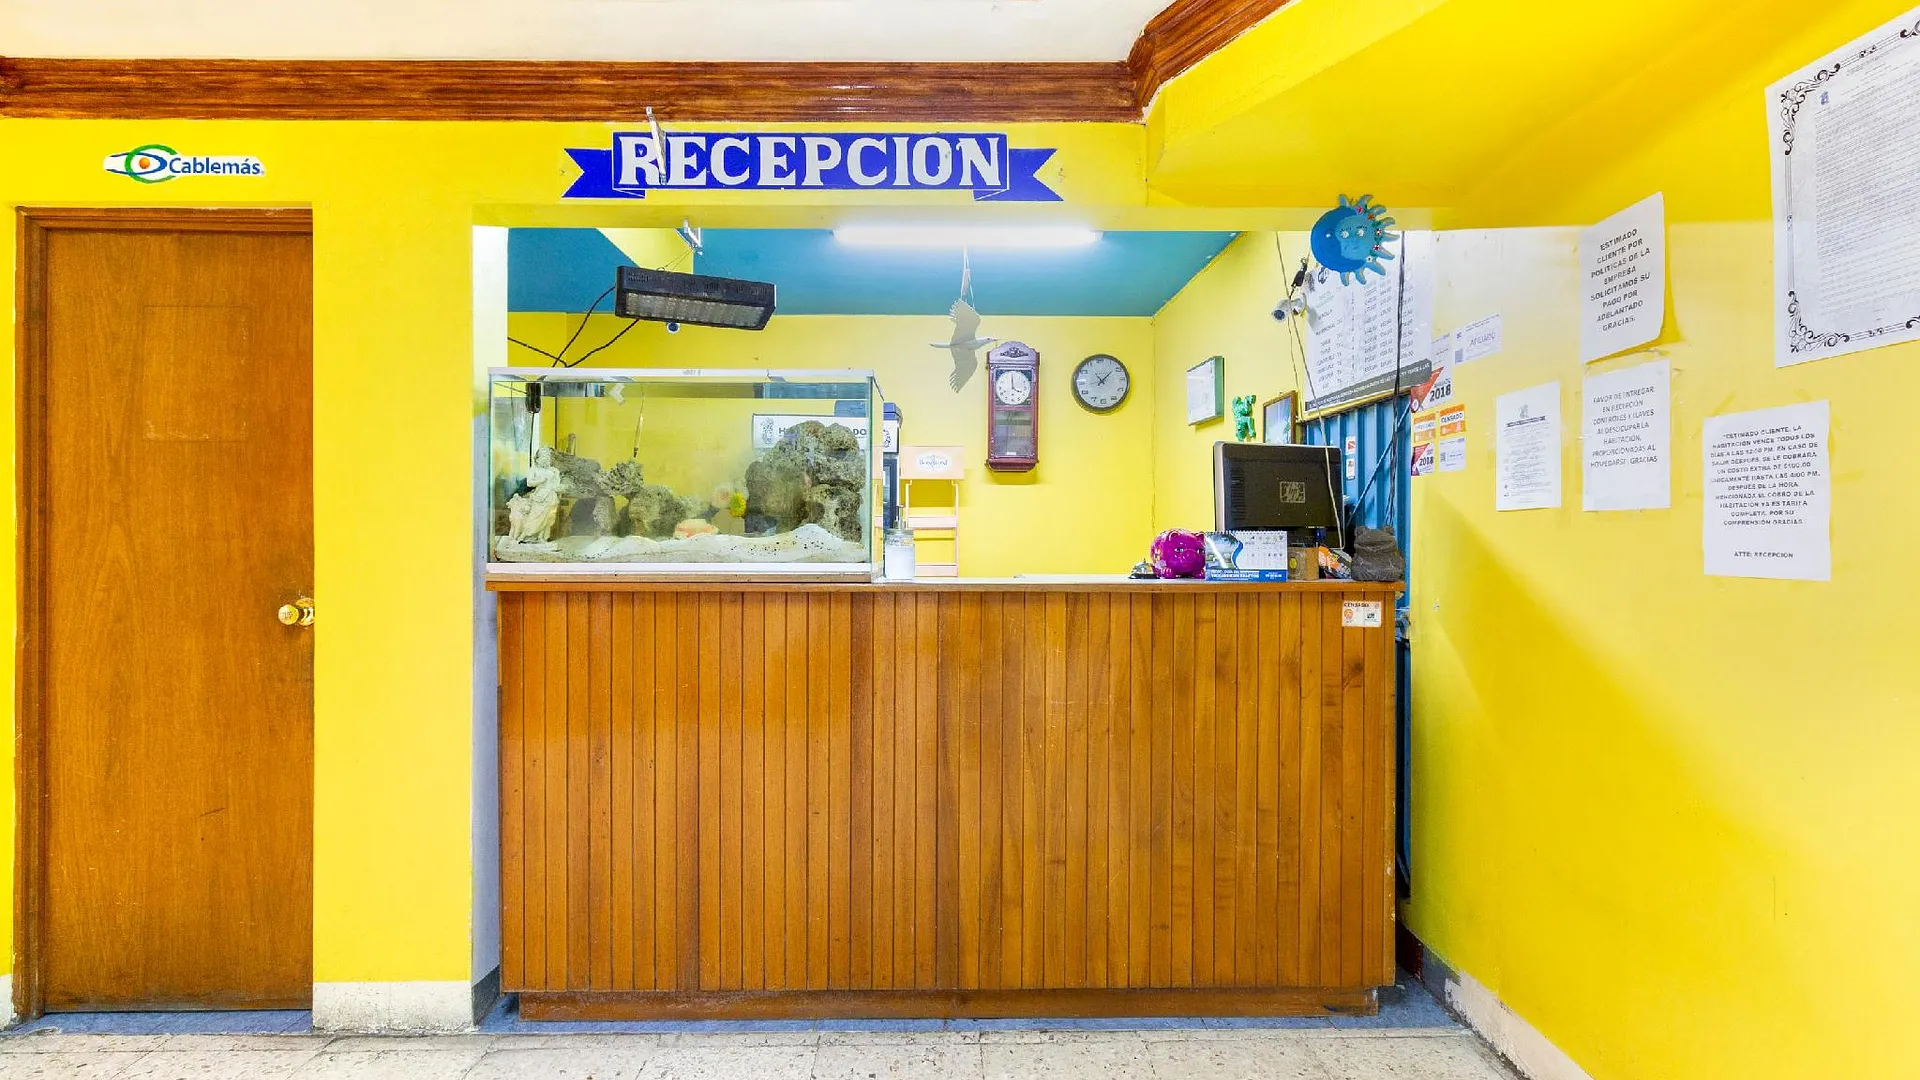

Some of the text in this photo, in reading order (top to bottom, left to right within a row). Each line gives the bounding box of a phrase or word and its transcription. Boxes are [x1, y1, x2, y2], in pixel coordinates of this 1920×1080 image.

[169, 157, 261, 175] Cablemás
[618, 135, 1002, 187] RECEPCION
[1600, 228, 1637, 250] ESTIMADO
[1597, 238, 1642, 263] CLIENTE POR
[1591, 248, 1650, 278] POLITICAS DE LA
[1604, 265, 1636, 285] EMPRESA
[1590, 272, 1650, 301] SOLICITAMOS SU
[1602, 289, 1638, 308] PAGO POR
[1597, 299, 1643, 322] ADELANTADO
[1429, 383, 1452, 402] 2018
[1593, 413, 1627, 425] CONTROLES
[1632, 408, 1655, 419] LLAVES
[1777, 434, 1800, 442] TODOS
[1808, 441, 1818, 449] DE
[1647, 444, 1657, 452] AL
[1782, 451, 1817, 460] COBRARA
[1419, 456, 1434, 467] 2018
[1630, 455, 1658, 464] GRACIAS
